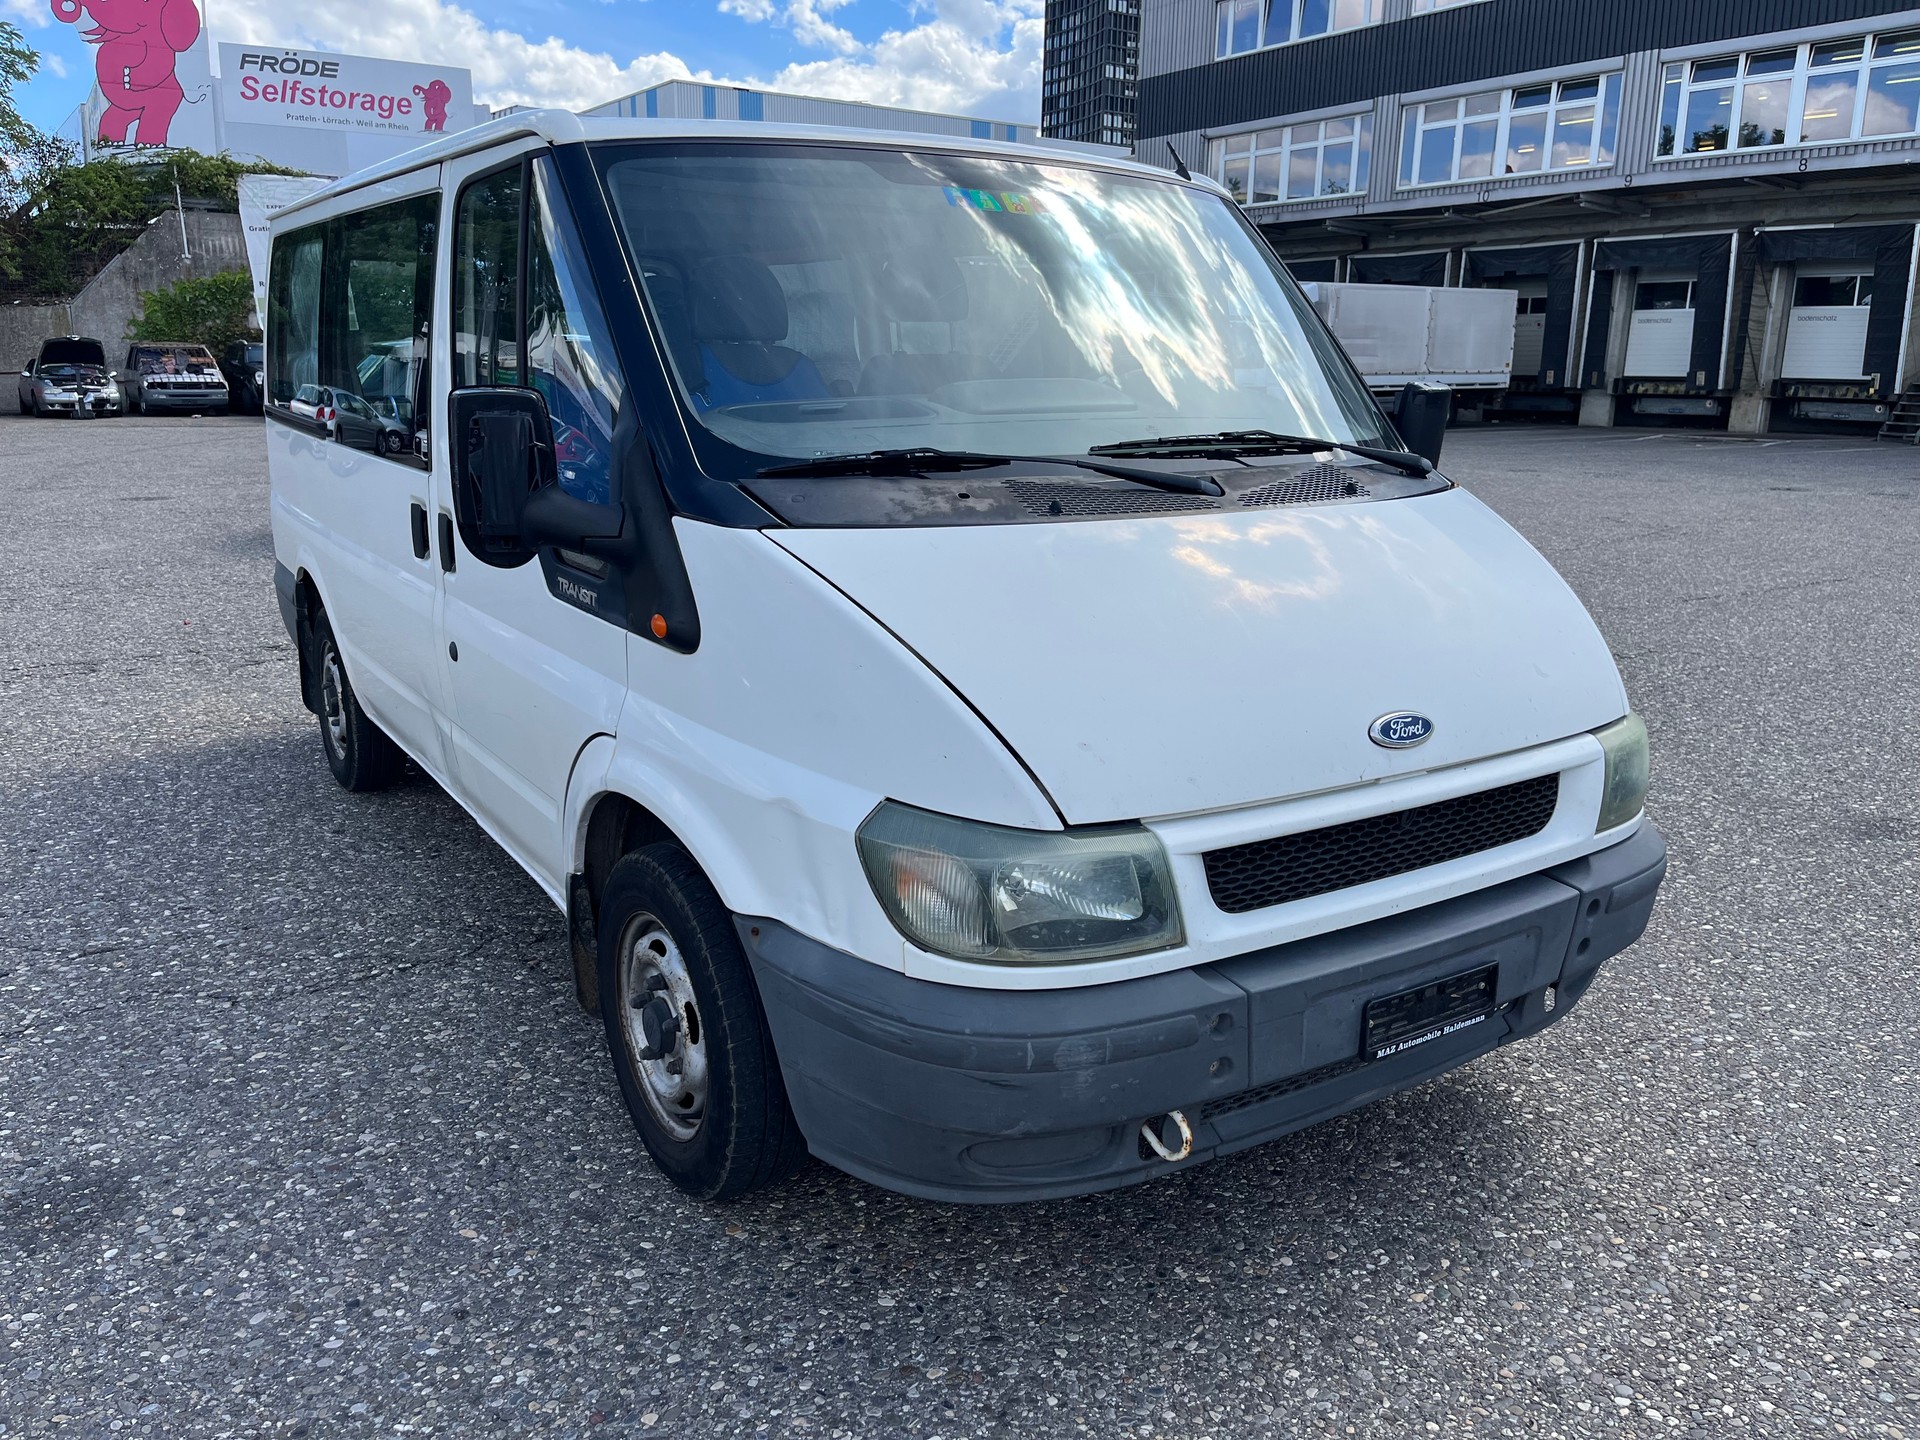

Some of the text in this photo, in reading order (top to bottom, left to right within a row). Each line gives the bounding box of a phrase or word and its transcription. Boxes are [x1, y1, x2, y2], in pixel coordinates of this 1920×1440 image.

[239, 51, 340, 79] FRÖDE
[239, 75, 413, 120] Selfstorage
[286, 113, 317, 122] Pratteln
[322, 116, 351, 125] Lörrach
[356, 119, 374, 128] Weil
[388, 123, 409, 131] Rhein
[1799, 158, 1808, 171] 8
[1624, 174, 1633, 187] 9
[1476, 190, 1490, 203] 10
[1253, 215, 1263, 225] 12
[557, 576, 598, 607] TRANSIT
[1390, 717, 1425, 739] Ford
[1376, 1014, 1485, 1058] MAZ Automobile Haldemann
